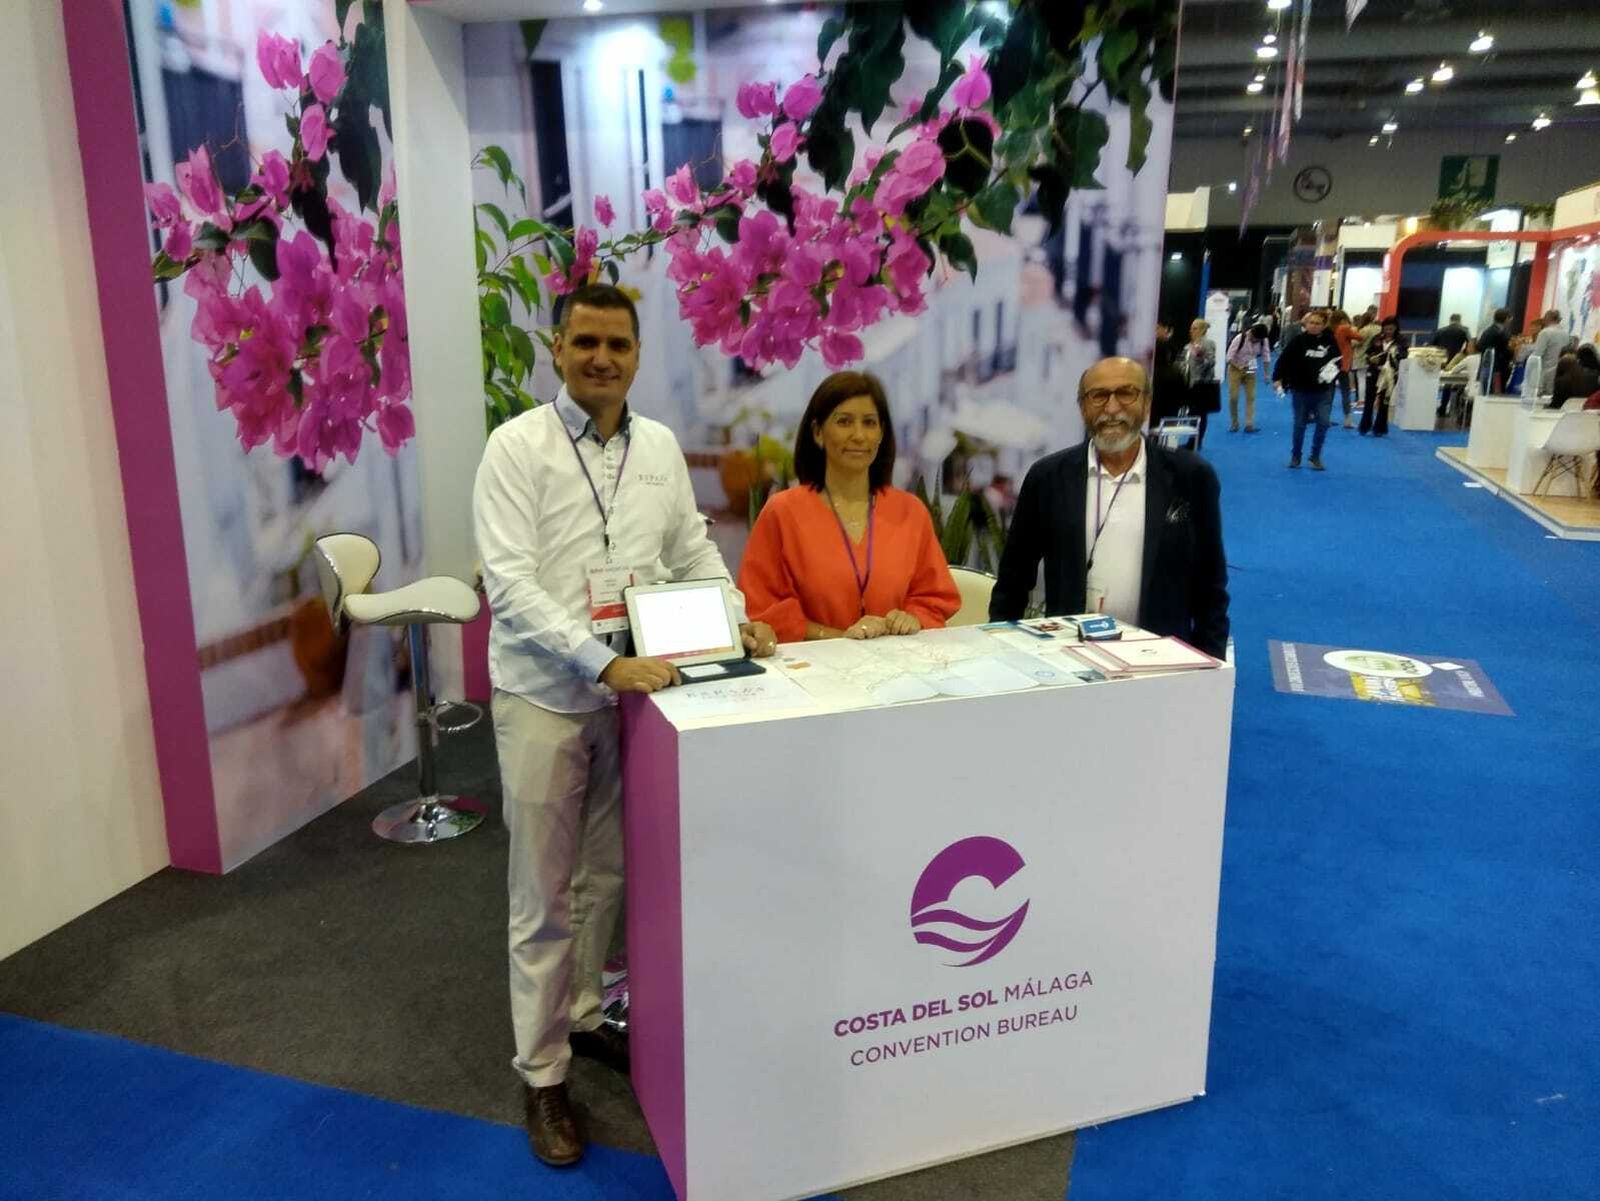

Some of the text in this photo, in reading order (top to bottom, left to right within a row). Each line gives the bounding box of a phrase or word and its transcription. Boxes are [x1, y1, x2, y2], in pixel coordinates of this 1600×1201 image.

[834, 971, 1093, 1038] COSTA DEL SOL MÁLAGA
[851, 1005, 1079, 1067] CONVENTION BUREAU
